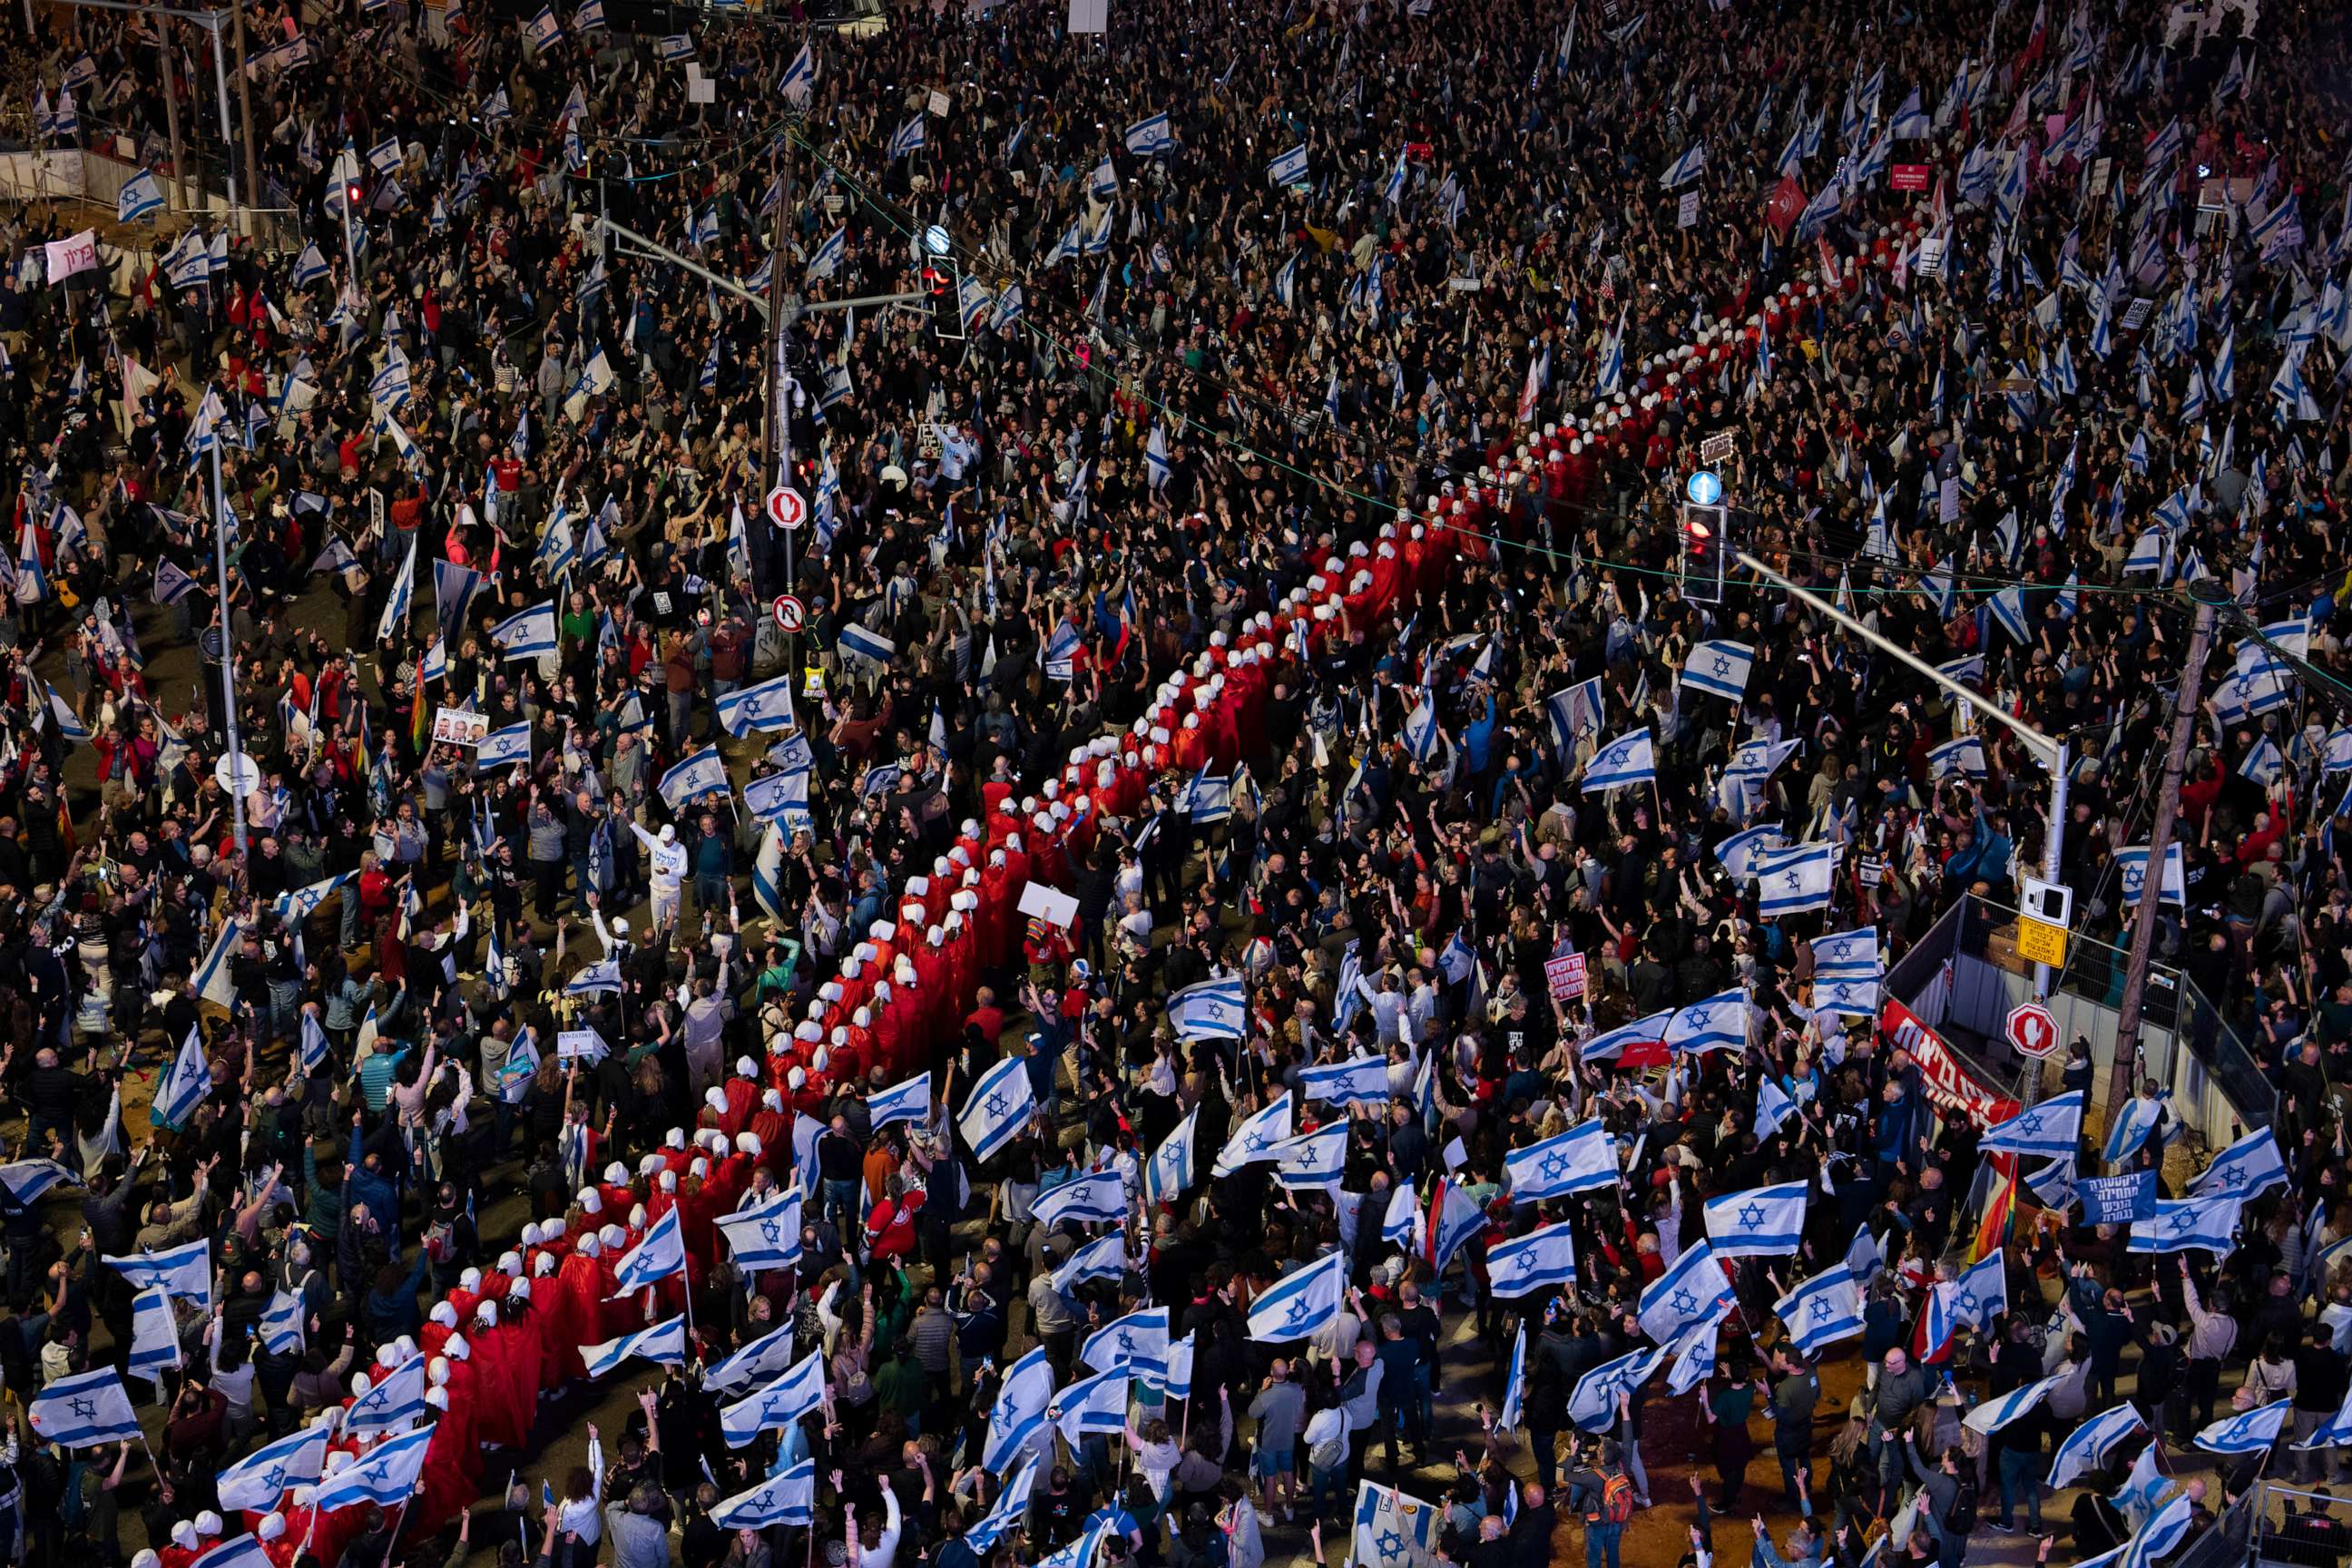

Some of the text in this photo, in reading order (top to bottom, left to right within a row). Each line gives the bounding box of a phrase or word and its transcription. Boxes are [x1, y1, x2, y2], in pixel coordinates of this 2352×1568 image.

[2130, 301, 2151, 314] SAVE
[2023, 919, 2046, 932] תחבורה
[2029, 929, 2054, 941] ציבורית
[2030, 936, 2051, 947] אכיפה
[2025, 941, 2055, 956] באמצעות
[2026, 949, 2053, 962] מצלמות
[1547, 956, 1583, 975] הרופאים
[1894, 1016, 1996, 1116] אין בריאות
[2089, 1173, 2141, 1191] דיקטטורה
[2102, 1199, 2132, 1213] הנפש
[2102, 1209, 2134, 1222] נגמרת
